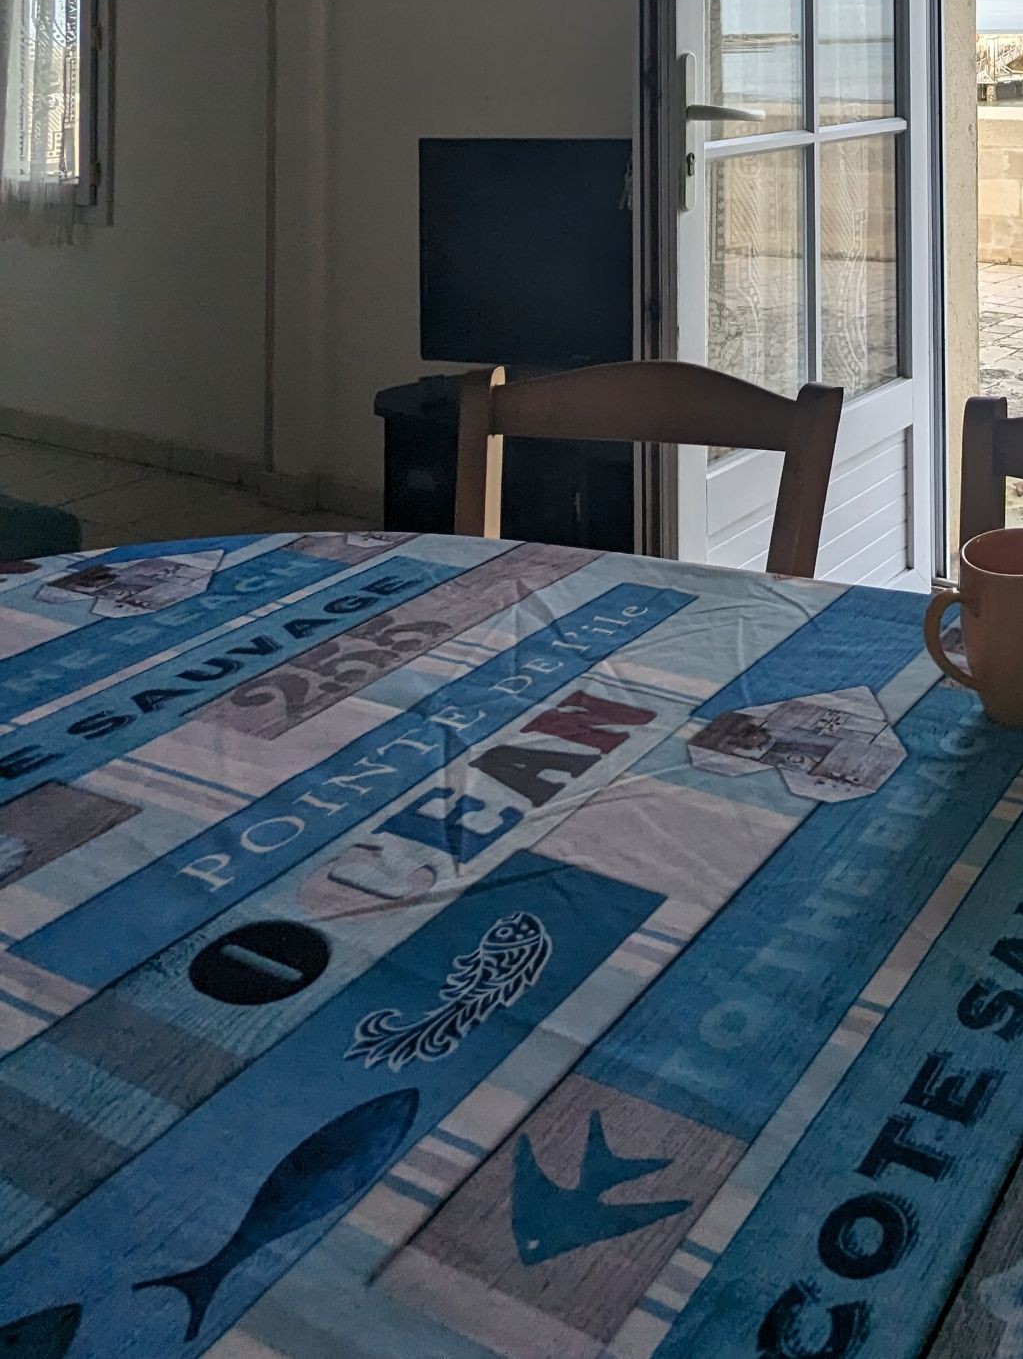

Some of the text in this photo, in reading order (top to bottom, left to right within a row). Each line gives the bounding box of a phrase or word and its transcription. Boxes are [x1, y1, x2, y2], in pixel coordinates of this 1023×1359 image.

[66, 577, 422, 741] SAUVAGE
[230, 615, 452, 715] 255
[175, 705, 487, 893] POINTE
[489, 658, 563, 696] DE
[756, 1050, 1007, 1359] COTE
